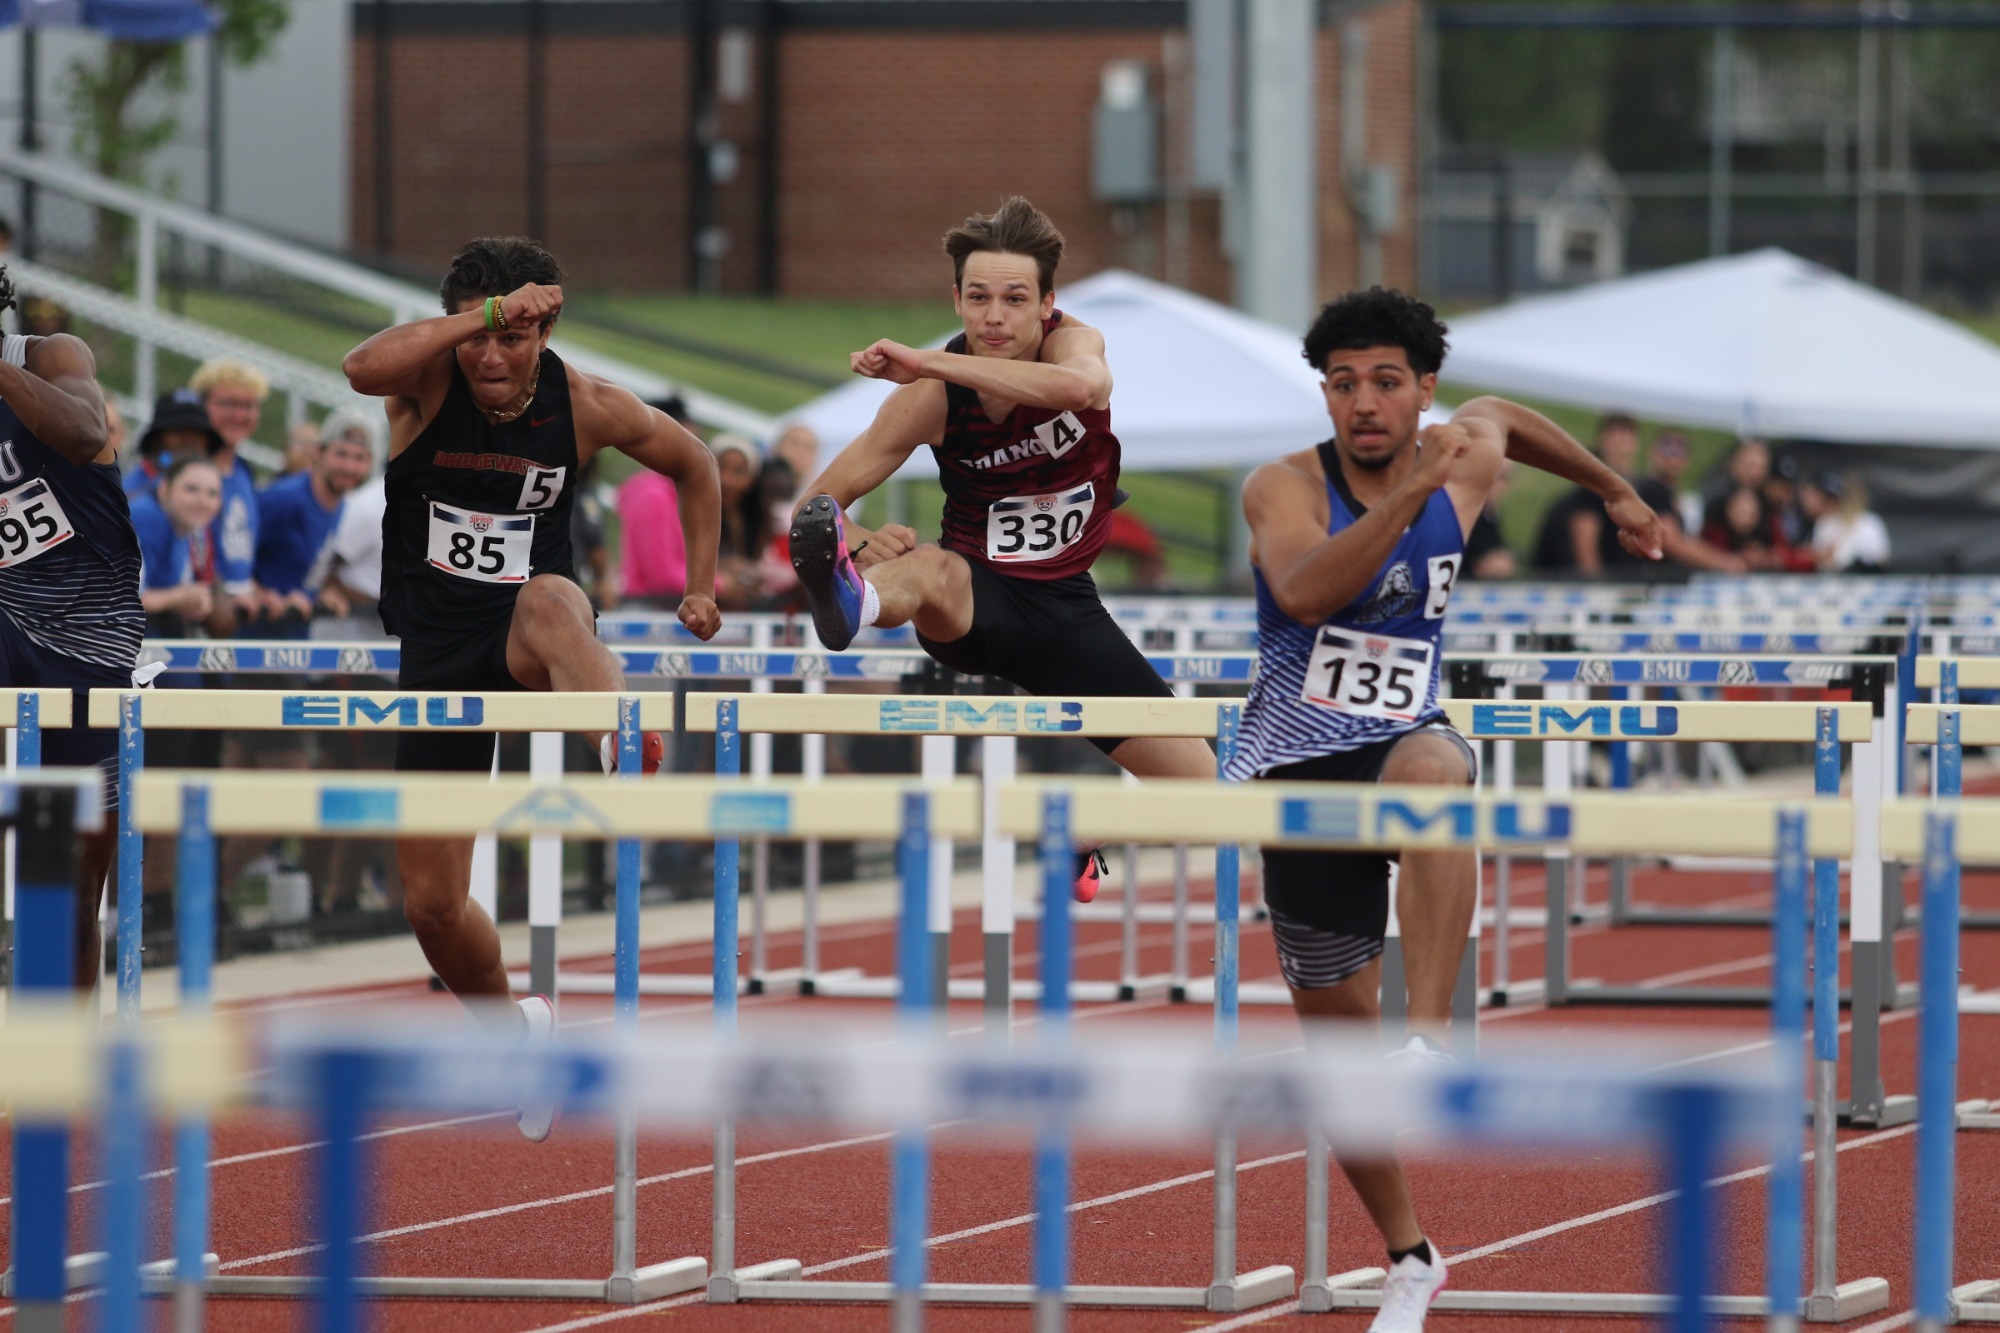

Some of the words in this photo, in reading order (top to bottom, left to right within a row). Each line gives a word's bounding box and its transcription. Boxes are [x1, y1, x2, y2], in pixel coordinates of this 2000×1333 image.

[1053, 418, 1077, 451] 4
[525, 471, 557, 508] 5
[0, 501, 58, 556] 95
[997, 509, 1083, 553] 330
[448, 532, 505, 574] 85
[1434, 560, 1454, 615] 3
[263, 648, 311, 668] EMU
[717, 653, 767, 674] EMU
[1173, 658, 1221, 678] EMU
[1642, 661, 1690, 682] EMU
[1323, 657, 1415, 710] 135
[282, 696, 484, 726] EMU
[1473, 705, 1678, 735] EMU
[1281, 799, 1572, 841] EMU
